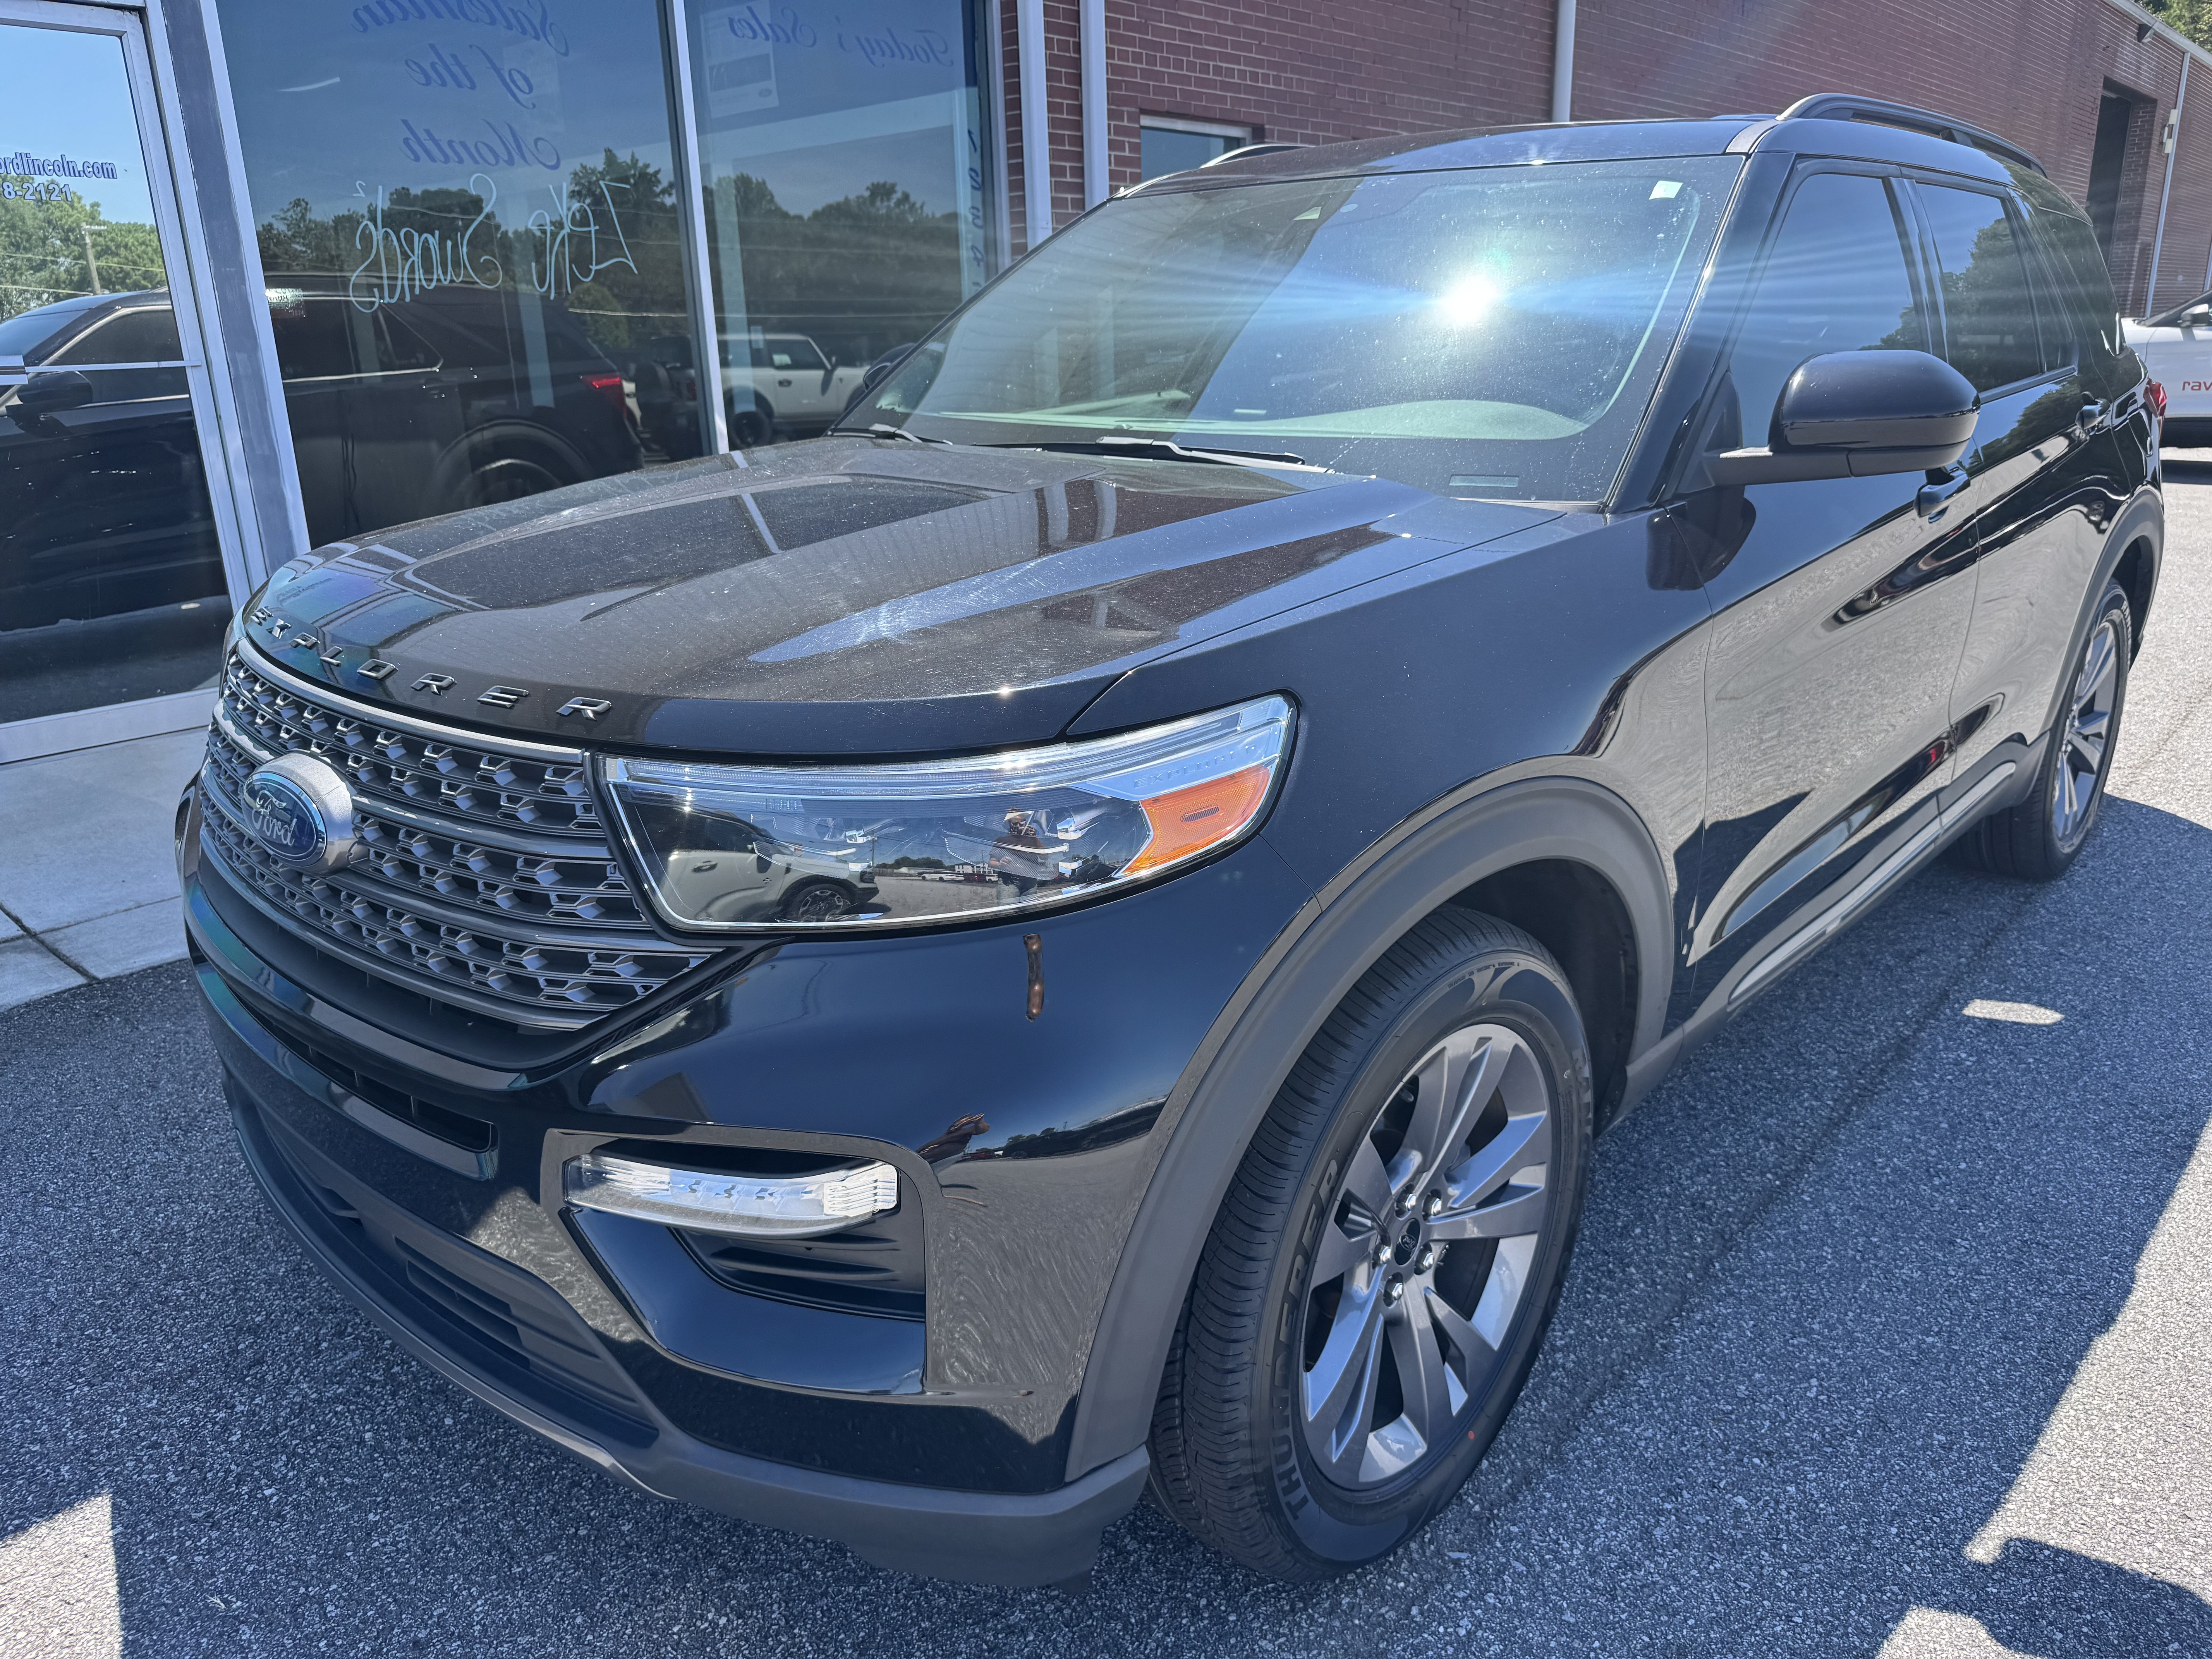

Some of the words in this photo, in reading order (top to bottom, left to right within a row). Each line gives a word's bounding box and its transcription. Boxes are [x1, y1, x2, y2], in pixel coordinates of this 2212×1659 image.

[2, 182, 72, 202] 8-2121
[250, 606, 612, 721] EXPLORER
[1133, 744, 1256, 788] EXPLORER
[252, 790, 297, 846] Ford
[1272, 1158, 1340, 1521] THUNDERER
